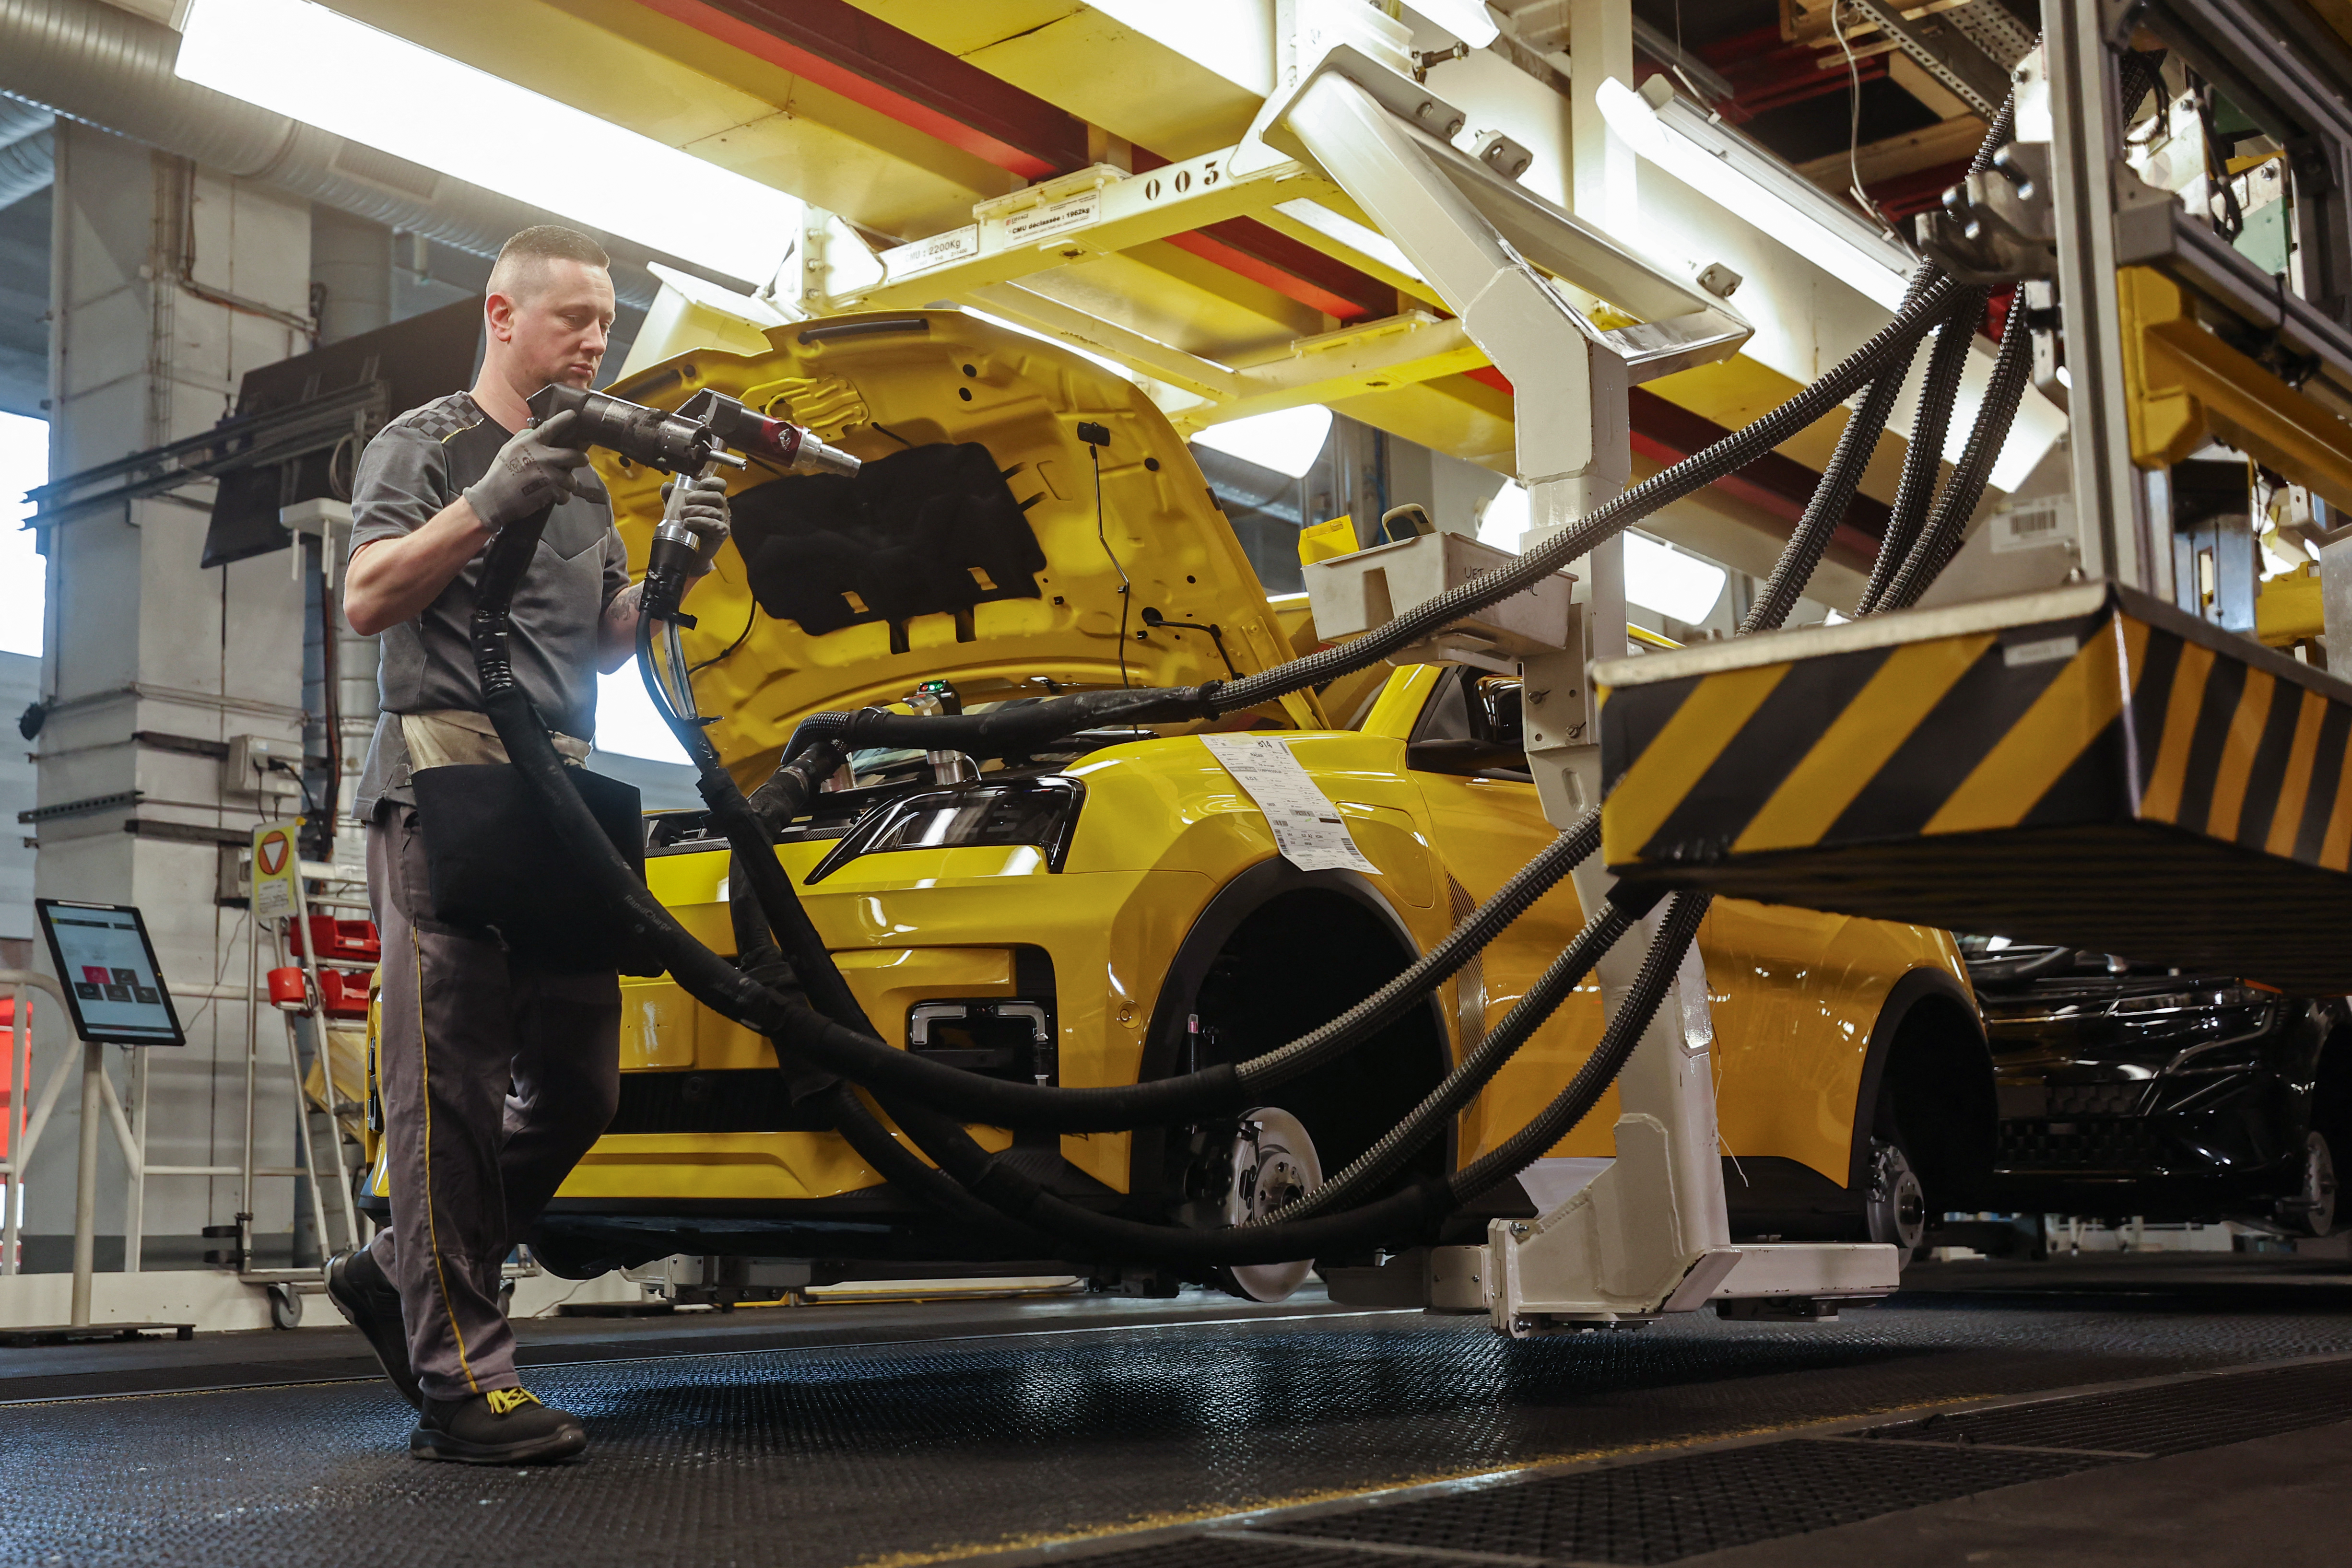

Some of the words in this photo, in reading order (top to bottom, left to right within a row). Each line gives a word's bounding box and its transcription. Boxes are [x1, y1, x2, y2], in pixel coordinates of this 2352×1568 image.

[1145, 161, 1219, 200] 003
[1012, 225, 1026, 234] CMU
[1029, 215, 1060, 229] déclassée
[1066, 207, 1090, 218] 1962kg
[906, 250, 920, 262] CMU
[929, 240, 961, 256] 2200Kg
